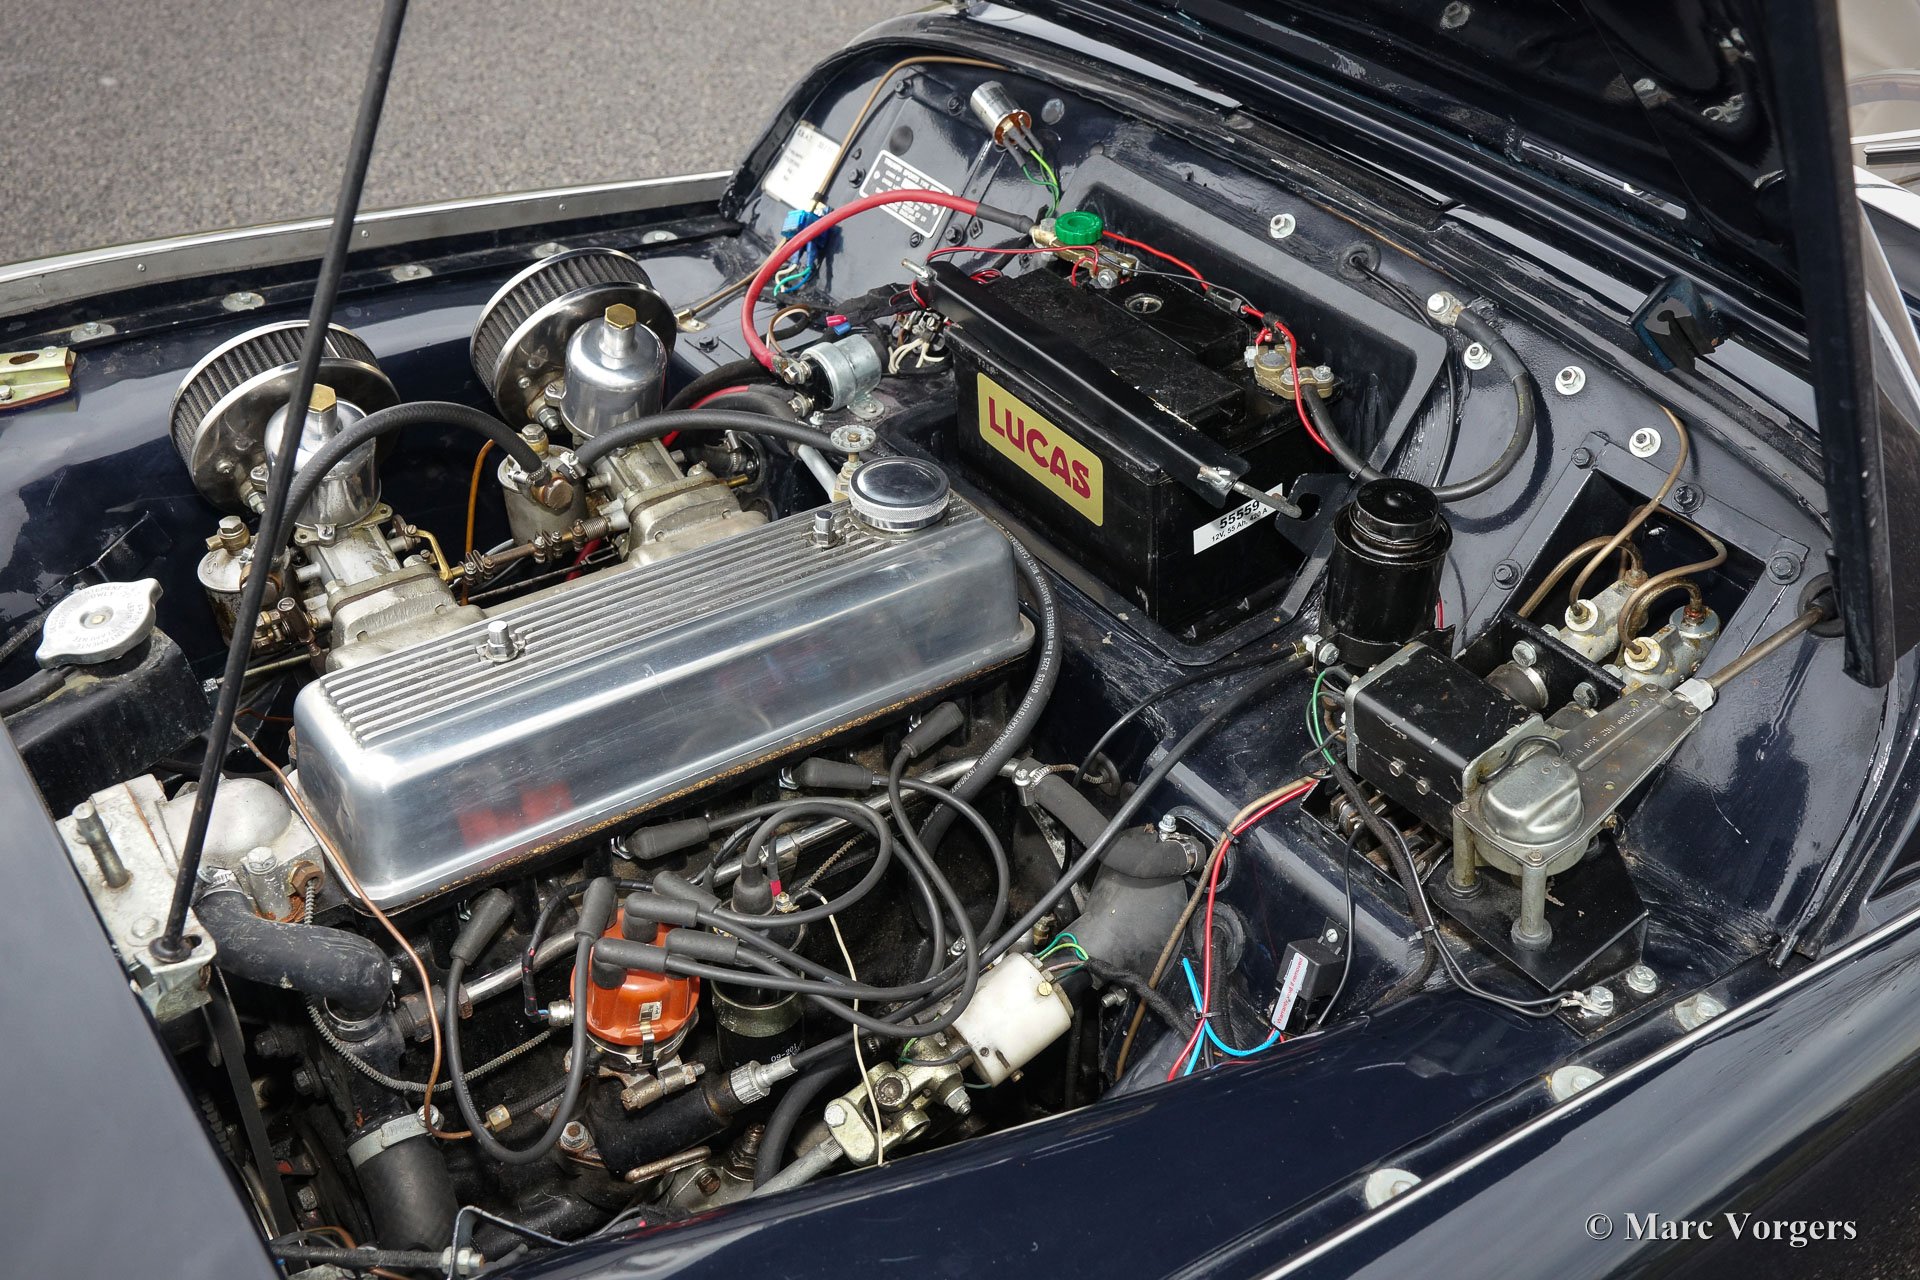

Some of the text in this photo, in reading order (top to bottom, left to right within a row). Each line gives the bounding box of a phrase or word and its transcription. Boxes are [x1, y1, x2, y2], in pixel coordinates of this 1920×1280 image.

[989, 396, 1091, 499] LUCAS
[1211, 531, 1226, 542] 12V,
[1228, 525, 1236, 534] 55
[1249, 511, 1261, 521] 420
[1219, 500, 1260, 529] 55559
[950, 766, 978, 795] ARBURANT
[979, 695, 1034, 766] UNIVERSALKRAFTSTOFF
[1031, 673, 1045, 694] GATES
[1046, 606, 1055, 639] UNIVERSELE
[1292, 958, 1304, 982] removed
